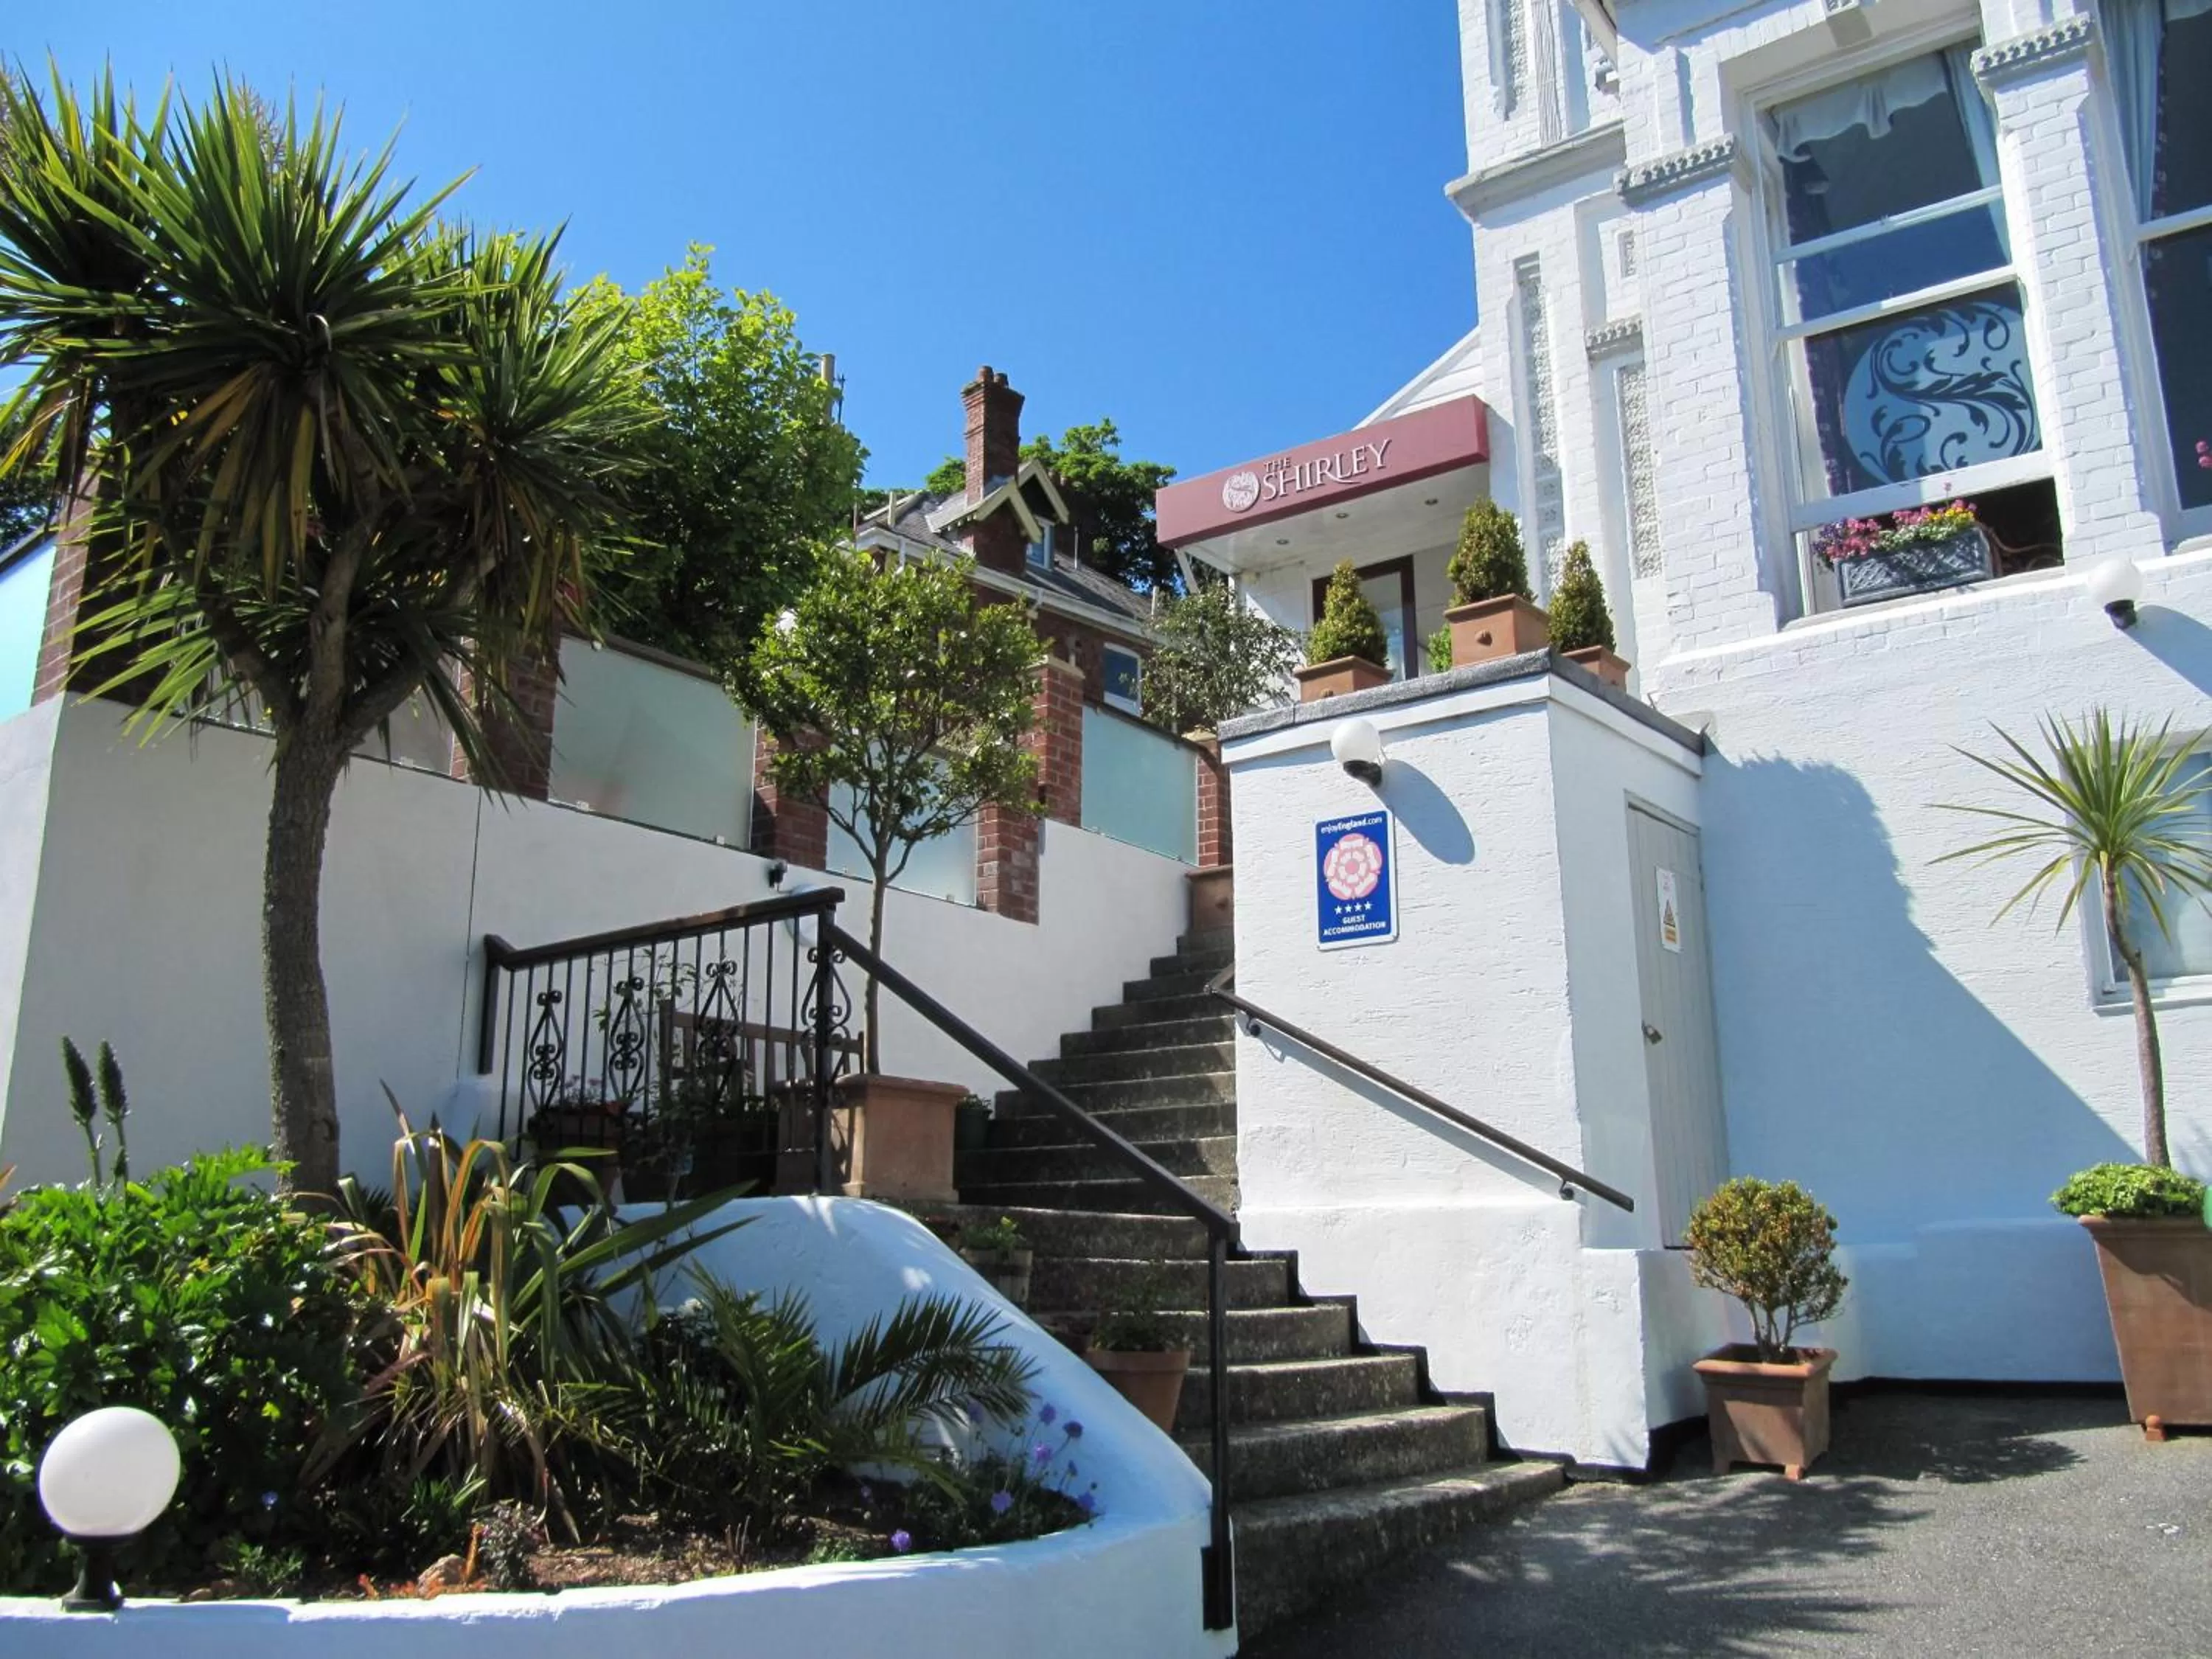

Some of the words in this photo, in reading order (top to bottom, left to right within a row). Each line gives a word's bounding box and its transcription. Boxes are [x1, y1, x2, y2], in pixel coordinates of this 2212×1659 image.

[1263, 439, 1391, 501] SHIRLEY
[1265, 457, 1291, 473] THE
[1343, 914, 1366, 924] GUEST
[1324, 922, 1385, 935] ACCOMMODATION
